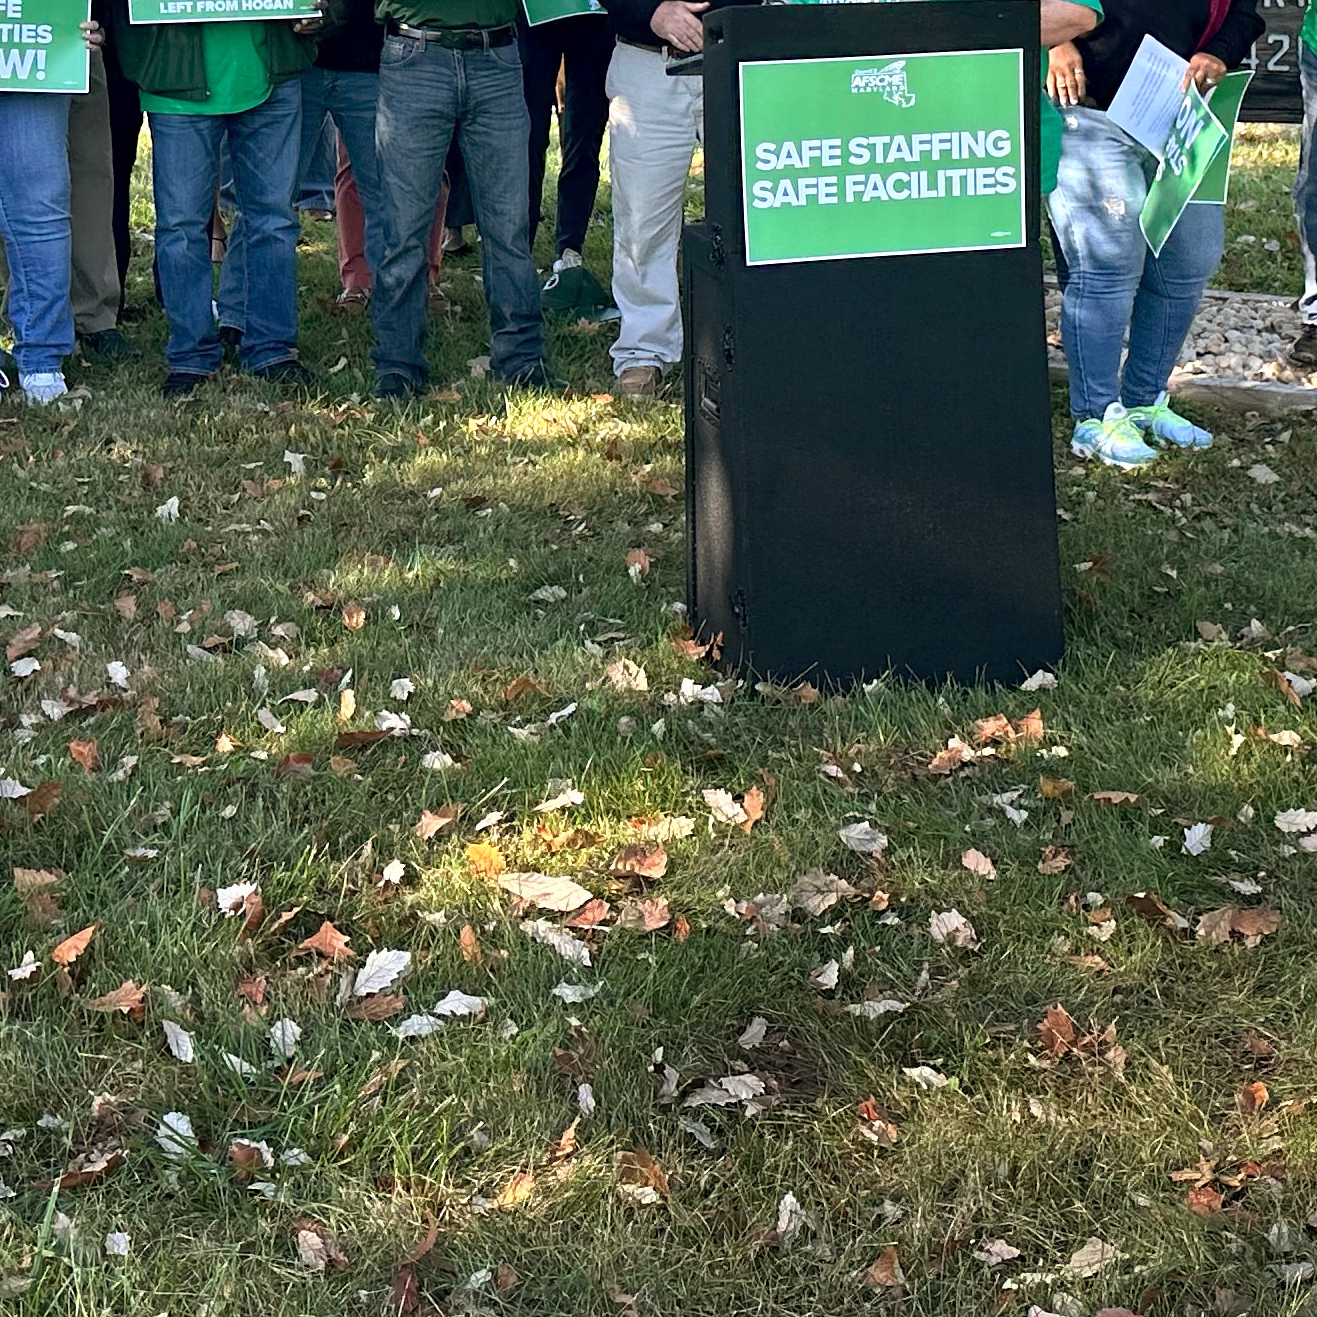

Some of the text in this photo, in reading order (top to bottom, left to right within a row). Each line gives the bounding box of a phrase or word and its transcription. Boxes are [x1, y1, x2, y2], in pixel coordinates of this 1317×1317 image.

[160, 1, 193, 14] LEFT
[197, 0, 238, 13] FROM
[755, 129, 1011, 171] SAFE STAFFING
[752, 166, 1016, 209] SAFE FACILITIES
